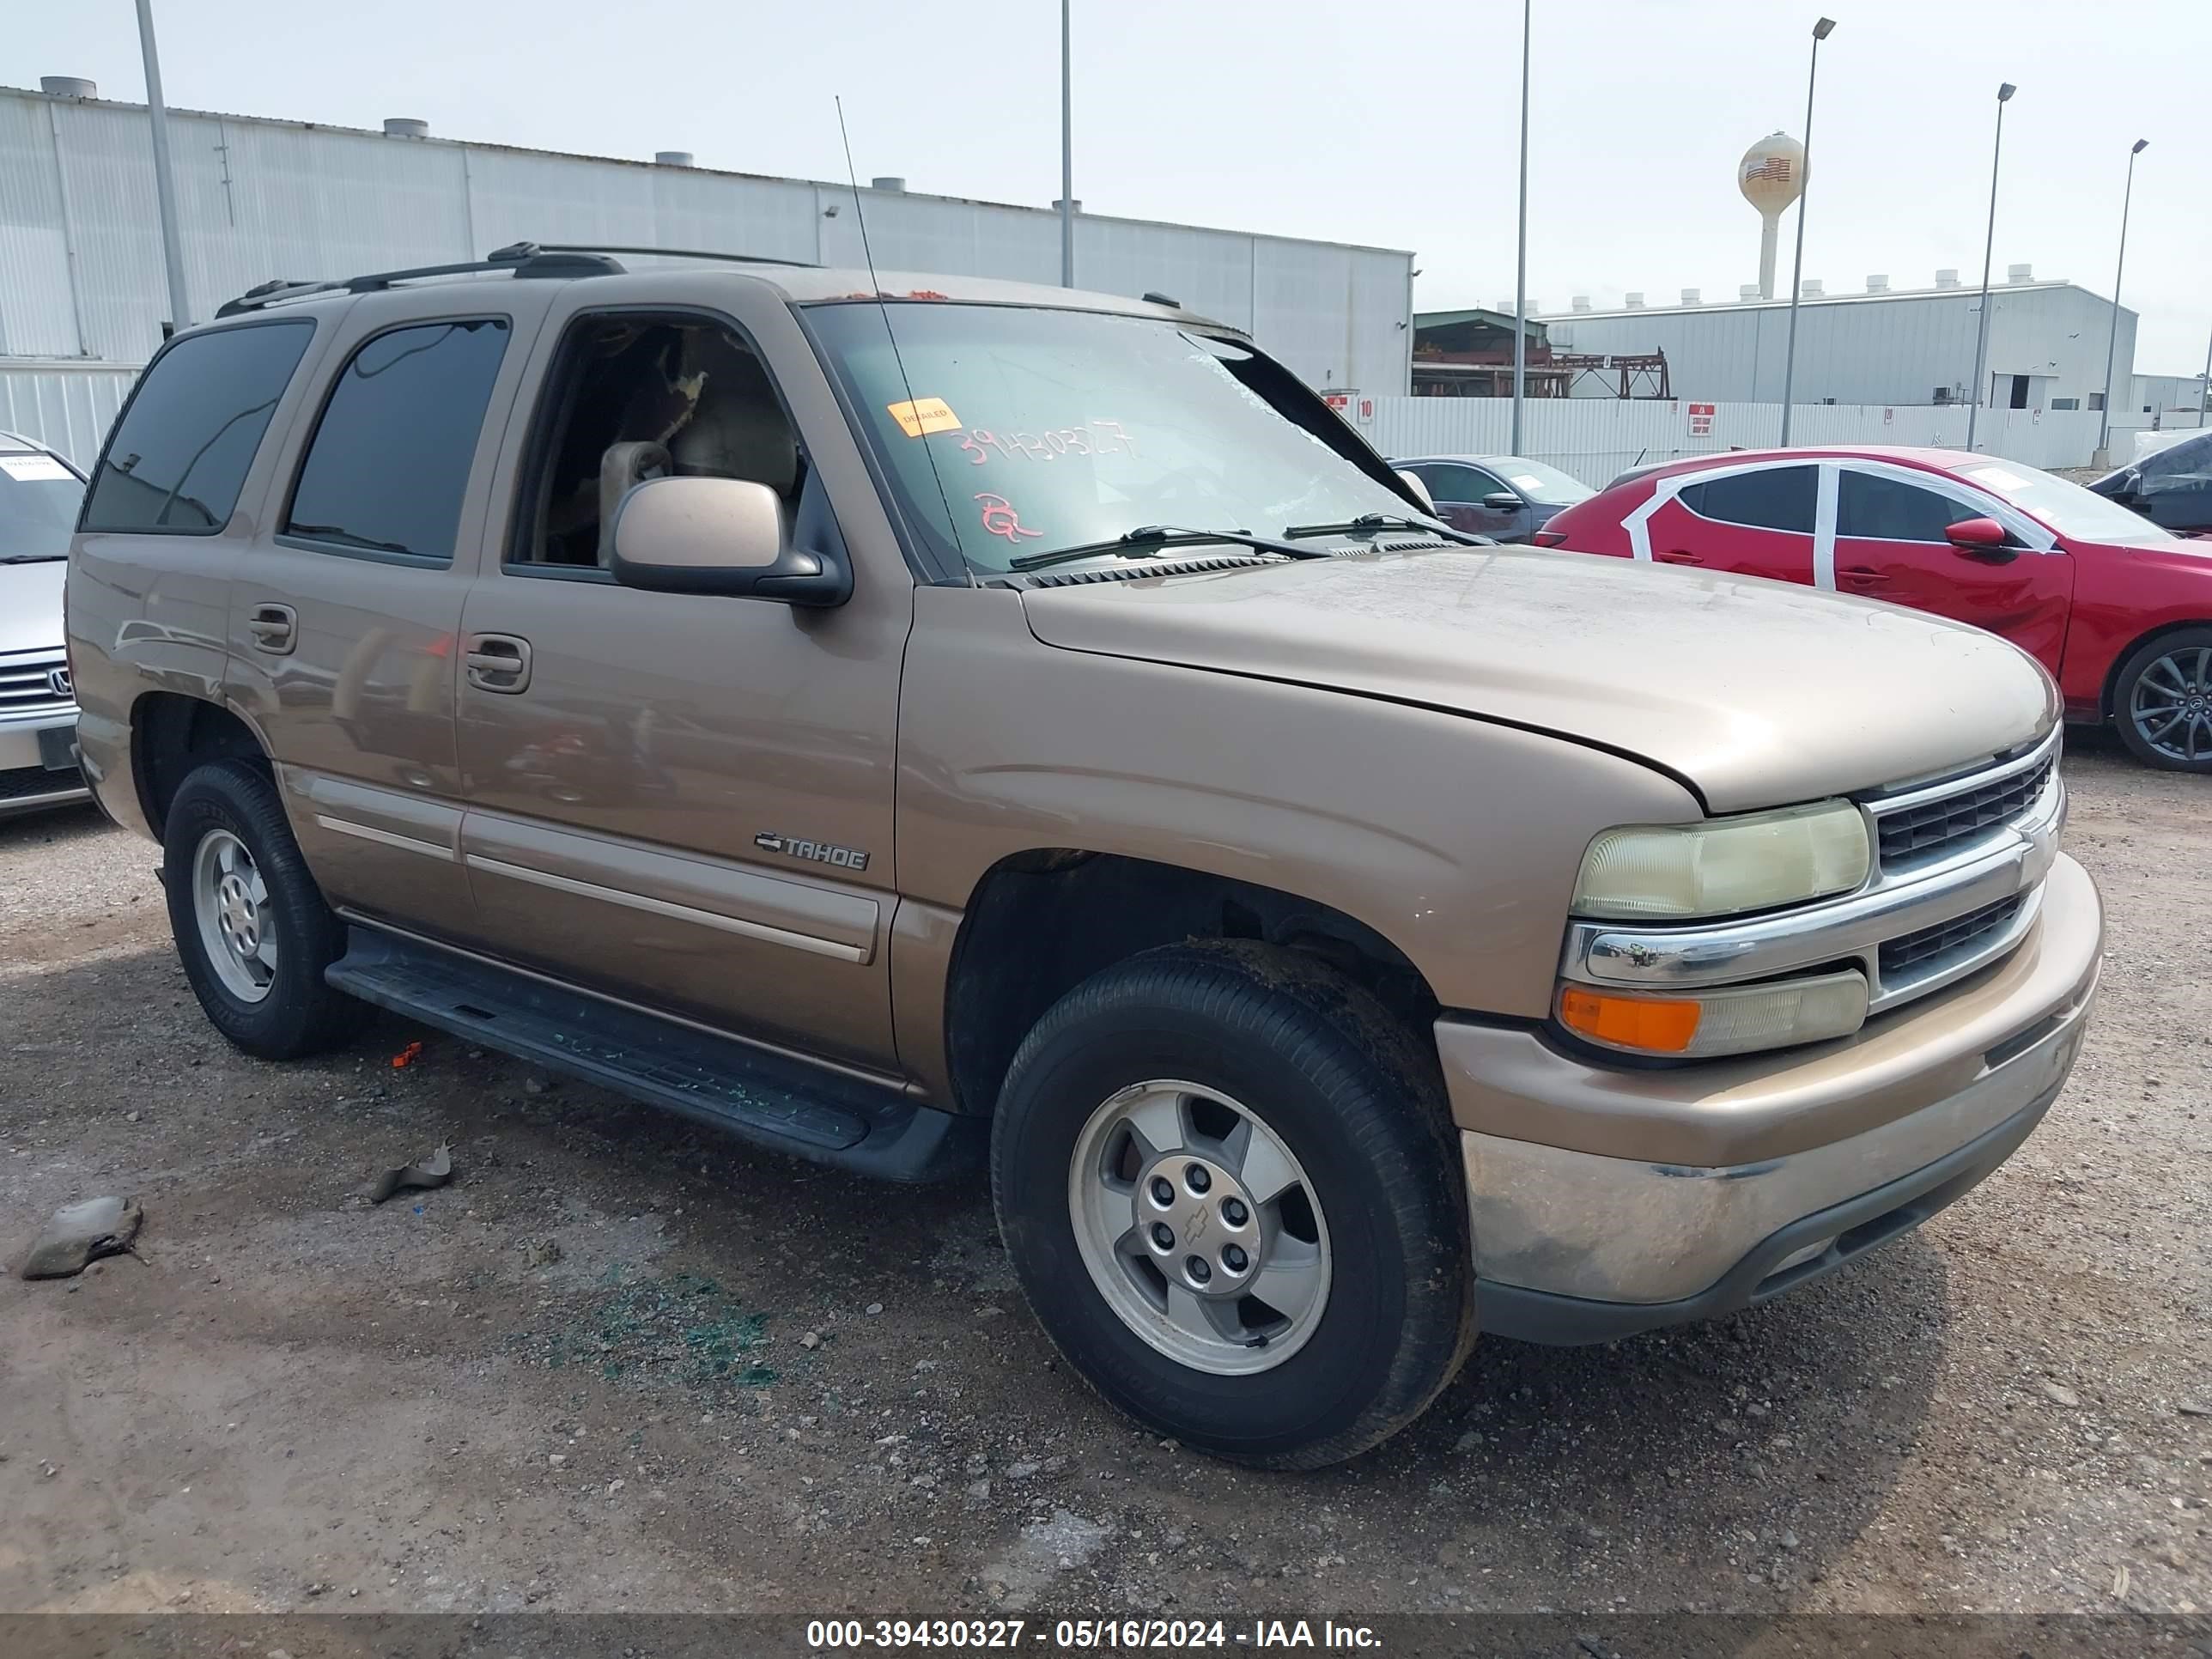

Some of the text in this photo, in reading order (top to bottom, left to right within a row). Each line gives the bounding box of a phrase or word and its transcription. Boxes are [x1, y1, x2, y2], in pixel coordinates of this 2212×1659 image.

[1361, 400, 1371, 417] 10
[950, 420, 1136, 465] 39430327
[785, 837, 870, 871] TAHOE
